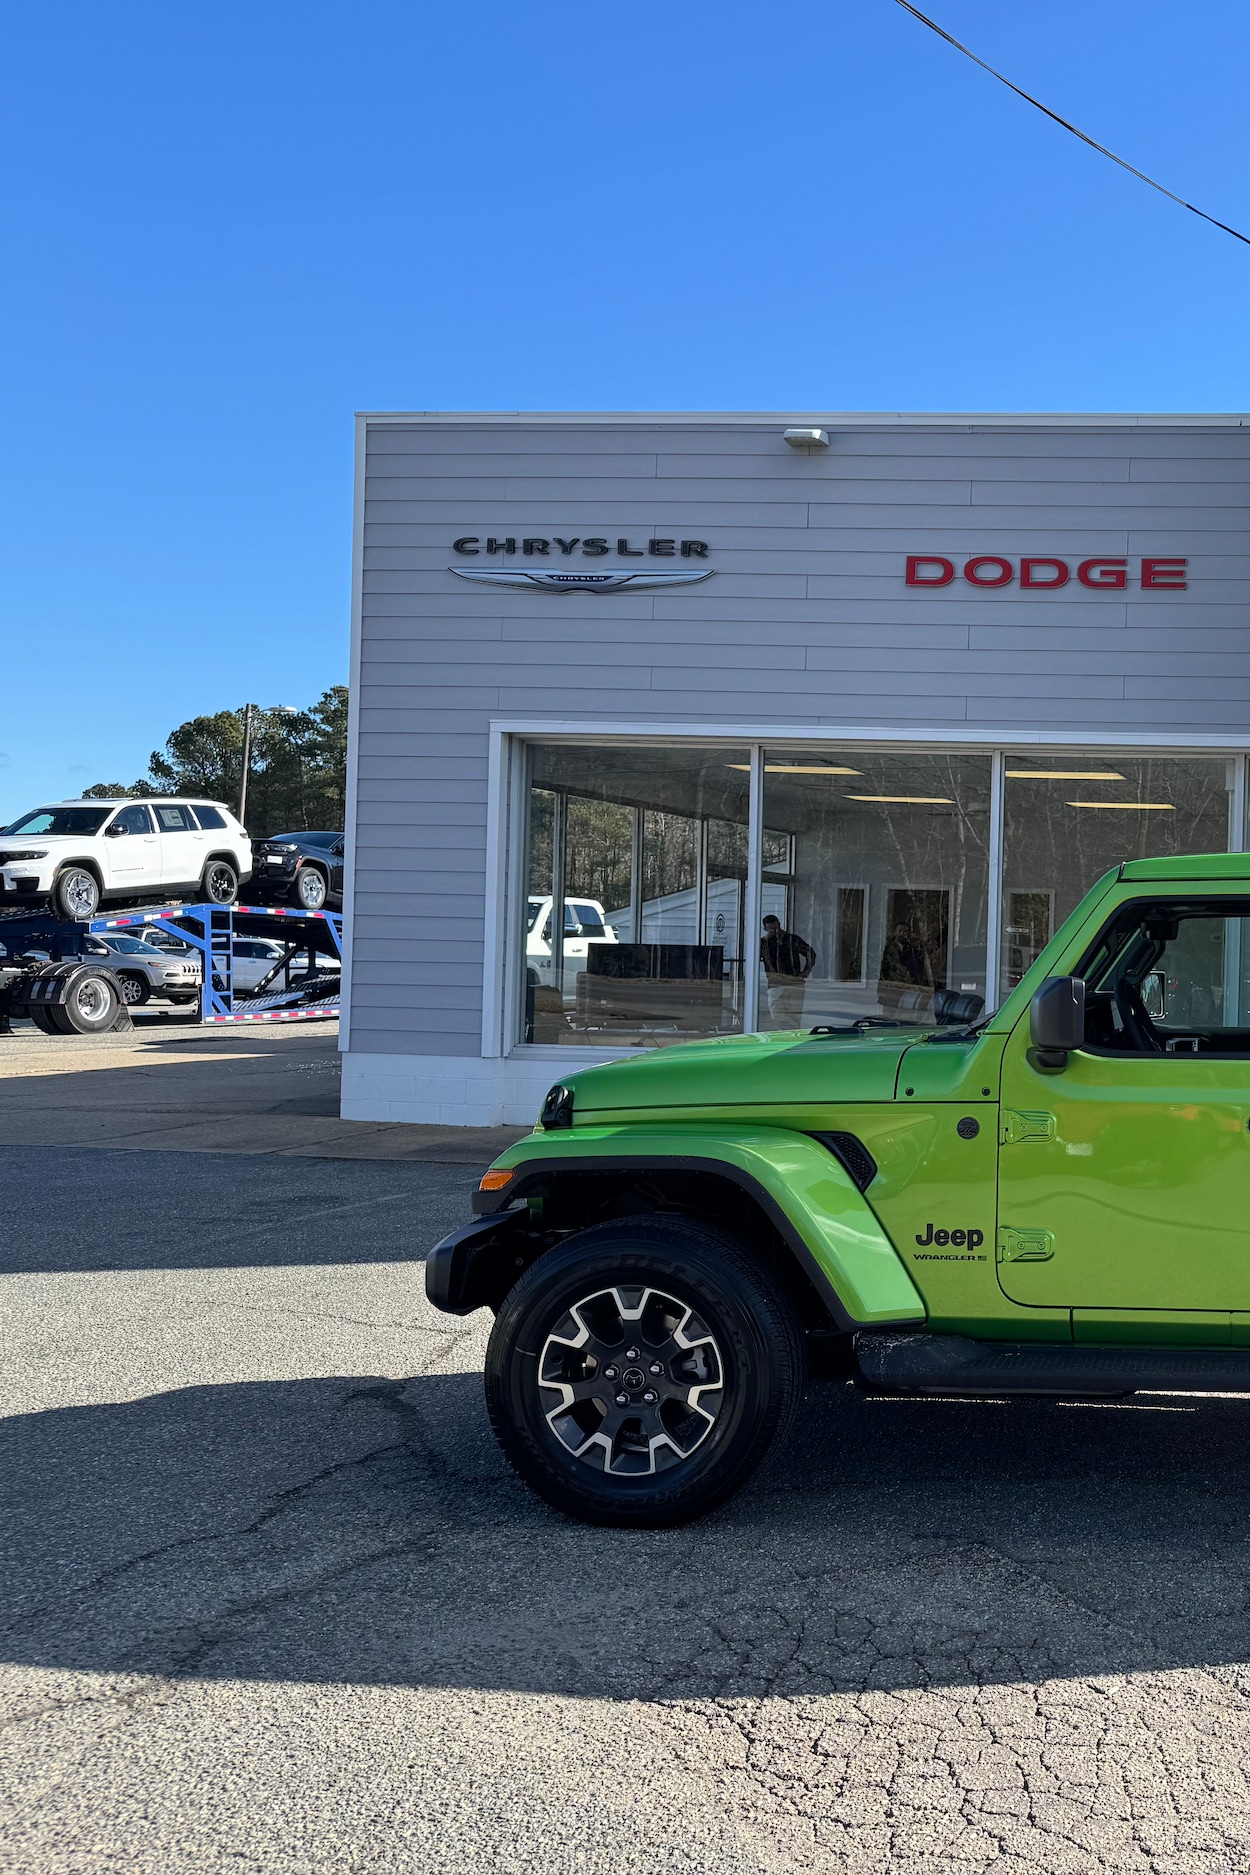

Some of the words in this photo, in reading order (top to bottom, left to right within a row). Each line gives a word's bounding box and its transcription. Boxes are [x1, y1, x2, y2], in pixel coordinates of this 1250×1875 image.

[453, 537, 708, 557] CHRYSLER
[905, 555, 1188, 590] DODGE
[915, 1223, 984, 1251] Jeep
